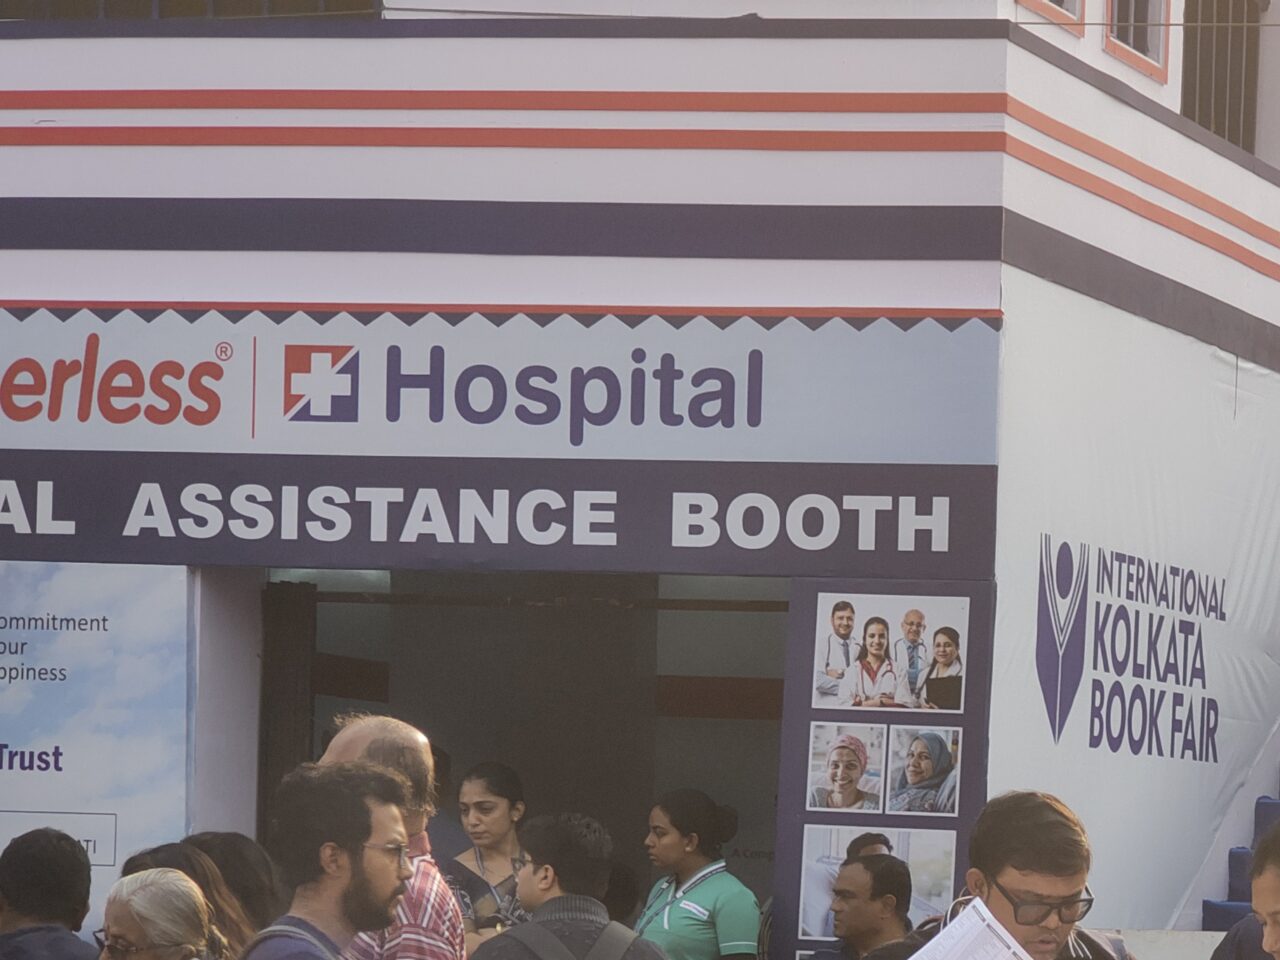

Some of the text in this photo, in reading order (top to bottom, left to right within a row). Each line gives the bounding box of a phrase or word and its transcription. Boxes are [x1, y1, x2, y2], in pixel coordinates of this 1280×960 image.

[385, 344, 764, 447] Hospital
[0, 479, 950, 552] AL ASSISTANCE BOOTH
[1096, 547, 1226, 622] INTERNATIONAL
[1092, 600, 1207, 690] KOLKATA
[0, 743, 63, 772] Trust
[1088, 678, 1219, 764] BOOK FAIR
